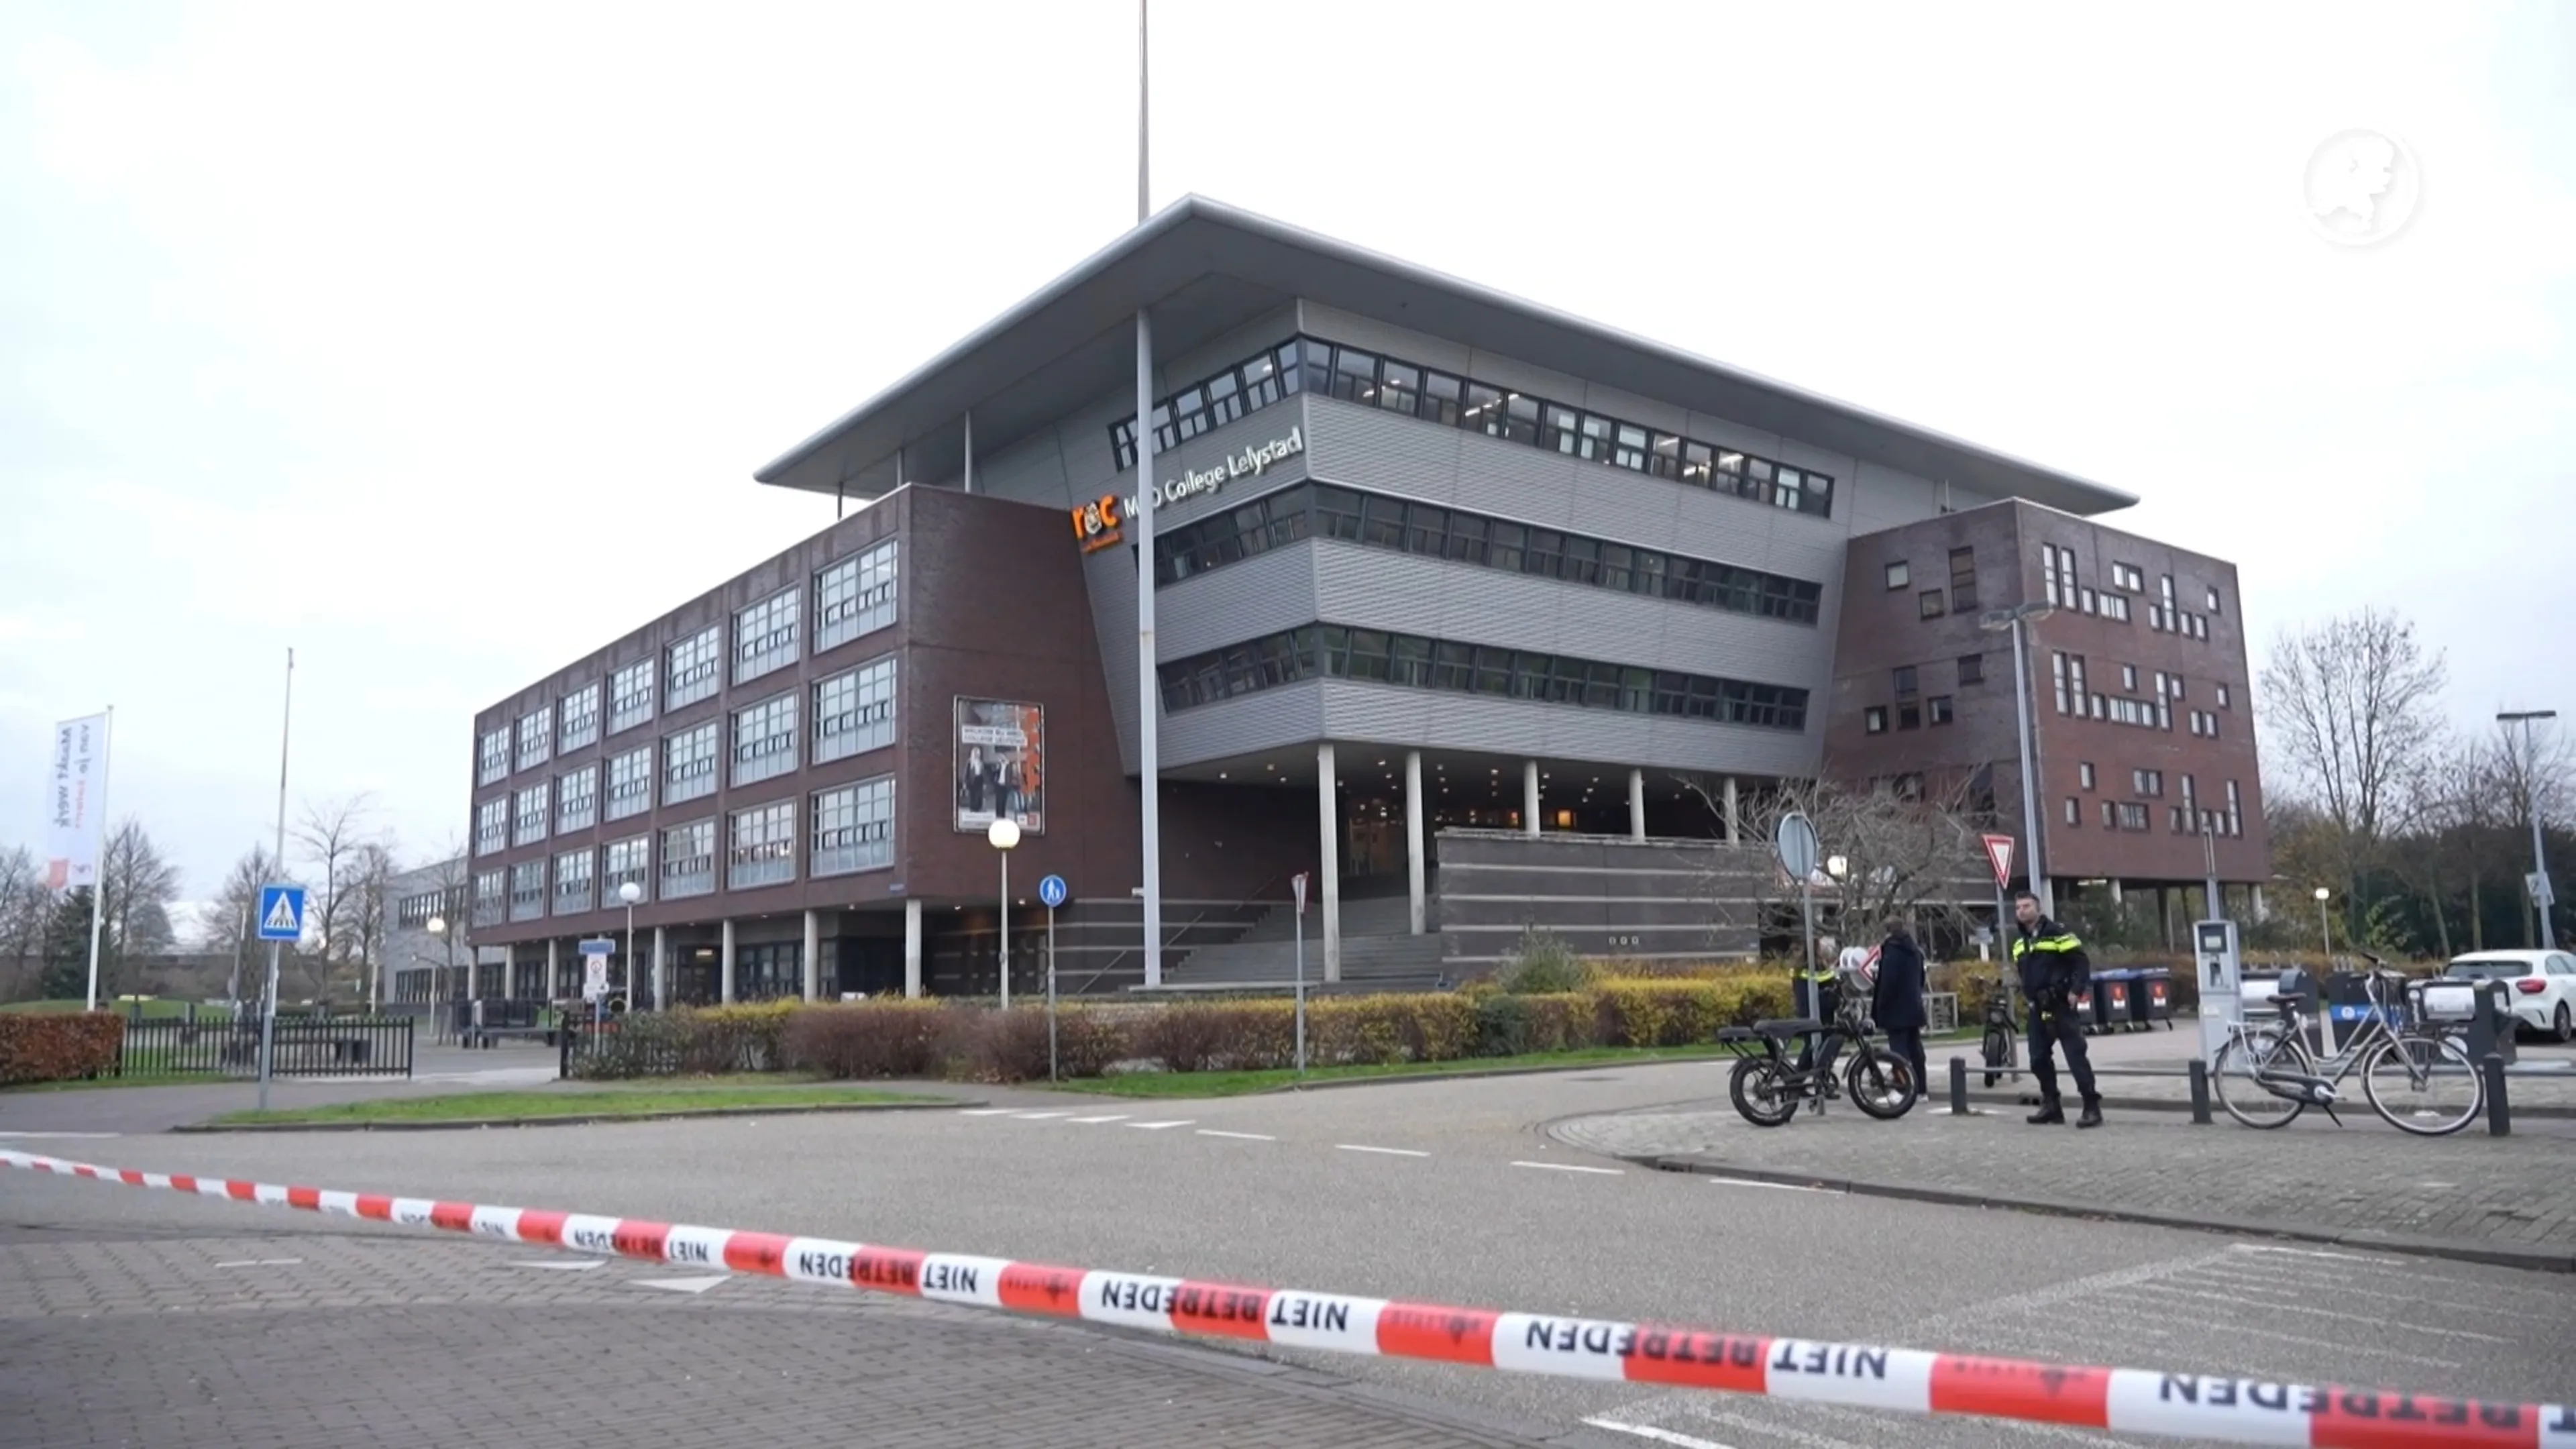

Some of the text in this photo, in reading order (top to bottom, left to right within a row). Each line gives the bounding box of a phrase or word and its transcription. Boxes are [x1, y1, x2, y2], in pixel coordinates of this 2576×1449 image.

[1124, 486, 1162, 519] MO
[1165, 464, 1225, 502] College
[1227, 425, 1303, 476] Lelystad
[668, 1240, 709, 1262] NIET
[800, 1252, 915, 1287] BETREDEN
[923, 1263, 978, 1293] NIET
[1101, 1279, 1262, 1322] BETREDEN
[1271, 1297, 1348, 1331] NIET
[1772, 1342, 1888, 1381] NIET
